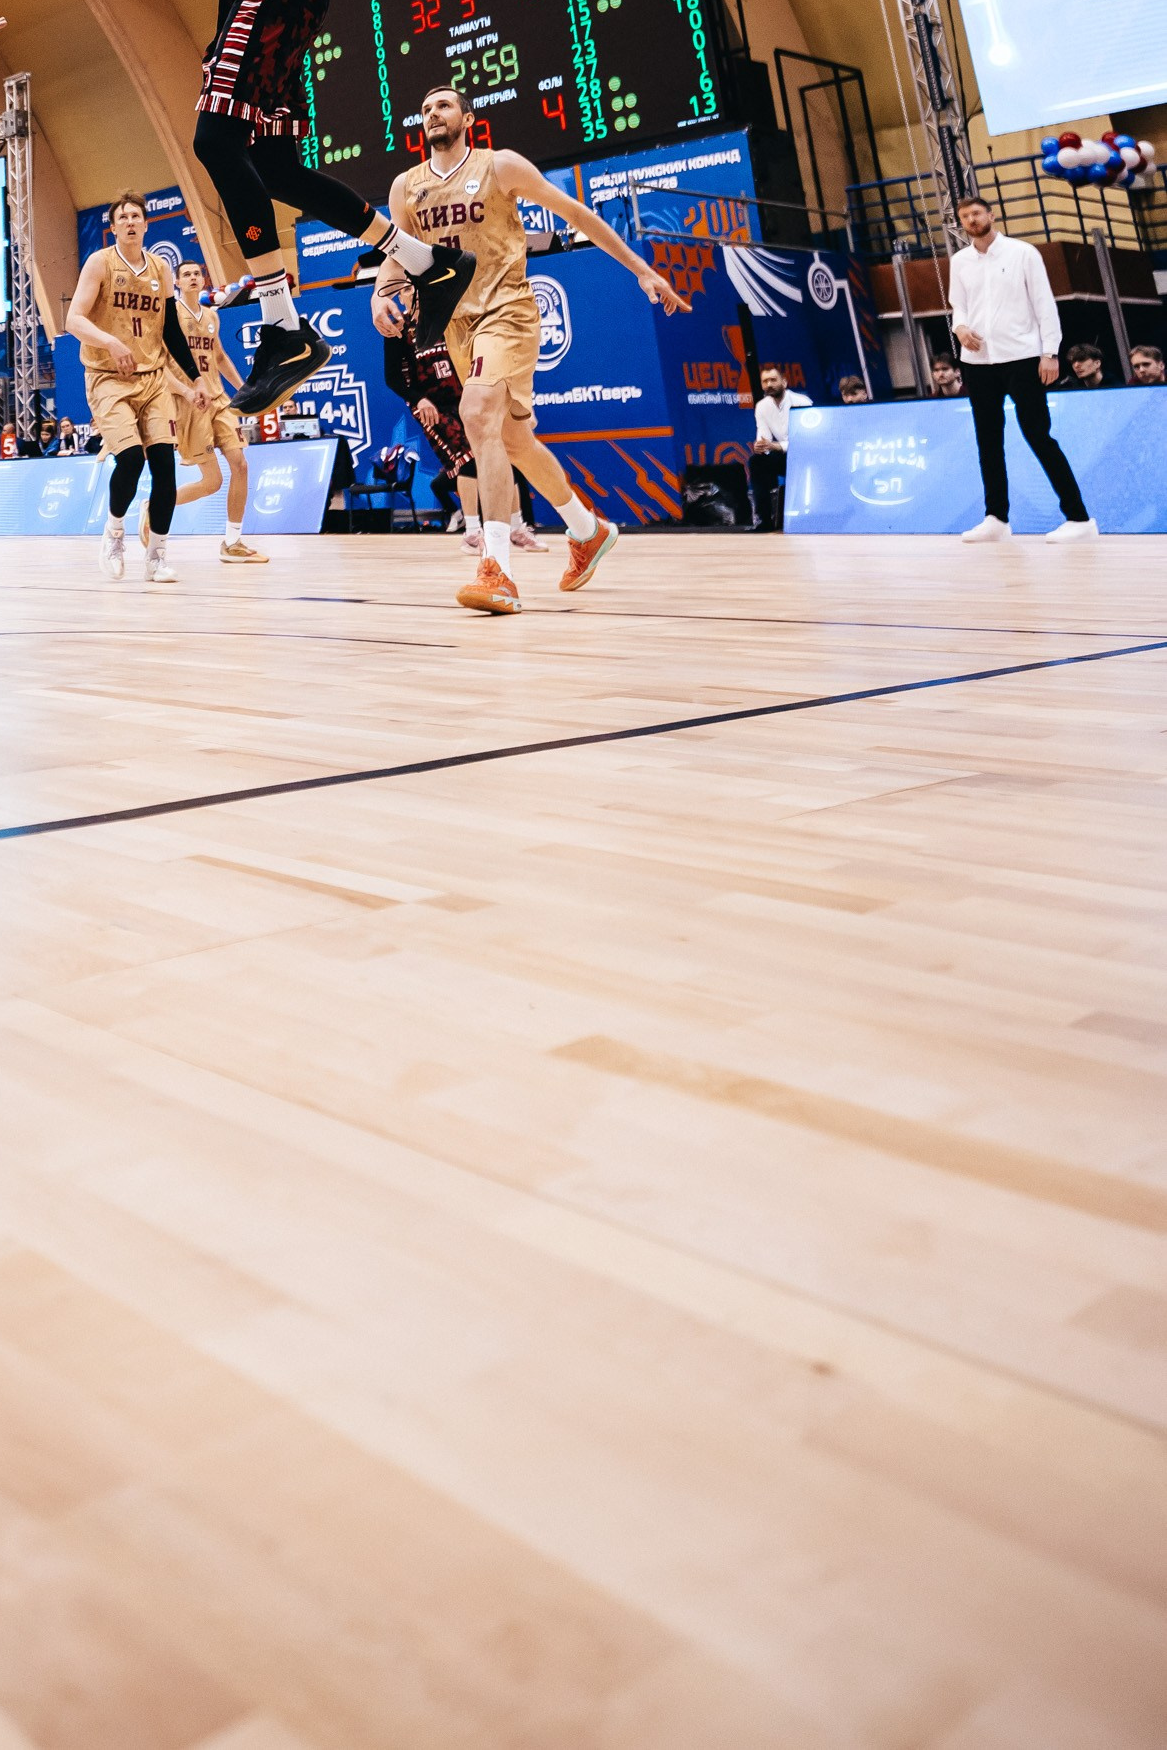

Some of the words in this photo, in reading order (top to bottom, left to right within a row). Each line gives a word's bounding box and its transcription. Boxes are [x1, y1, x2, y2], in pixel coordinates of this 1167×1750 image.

[372, 13, 382, 31] 8
[567, 0, 591, 24] 15
[689, 8, 702, 30] 0
[448, 15, 492, 38] ТАЙМАУТЫ
[570, 20, 592, 44] 17
[374, 30, 383, 48] 0
[445, 40, 473, 57] ВРЕМЯ
[476, 32, 499, 49] ИГРЫ
[692, 29, 706, 50] 0
[376, 47, 386, 65] 9
[572, 39, 596, 64] 23
[696, 50, 707, 72] 1
[378, 64, 388, 81] 0
[450, 43, 520, 94] 2:59
[574, 57, 598, 83] 27
[380, 81, 390, 98] 0
[538, 75, 563, 91] ФОЛЫ
[577, 78, 602, 103] 28
[700, 71, 713, 93] 6
[382, 98, 391, 116] 0
[473, 88, 517, 109] ПЕРЕРЫВА
[689, 92, 717, 117] 13
[541, 93, 567, 131] 4
[580, 98, 602, 123] 31
[383, 115, 393, 133] 7
[583, 118, 608, 142] 35
[301, 136, 319, 157] 33
[385, 133, 395, 152] 2
[405, 129, 426, 163] 4
[304, 153, 319, 170] 41
[589, 171, 627, 190] СРЕДИ
[688, 148, 742, 171] КОМАНД
[416, 201, 484, 233] ЦИВС
[113, 291, 161, 313] ЦИВС
[132, 317, 143, 338] 11
[198, 355, 209, 372] 15
[433, 360, 452, 379] 12
[683, 362, 739, 392] ЦЕЛЬ
[722, 393, 734, 405] ГОД
[263, 413, 278, 435] 5
[319, 401, 357, 429] 4-Х
[3, 438, 15, 455] 5
